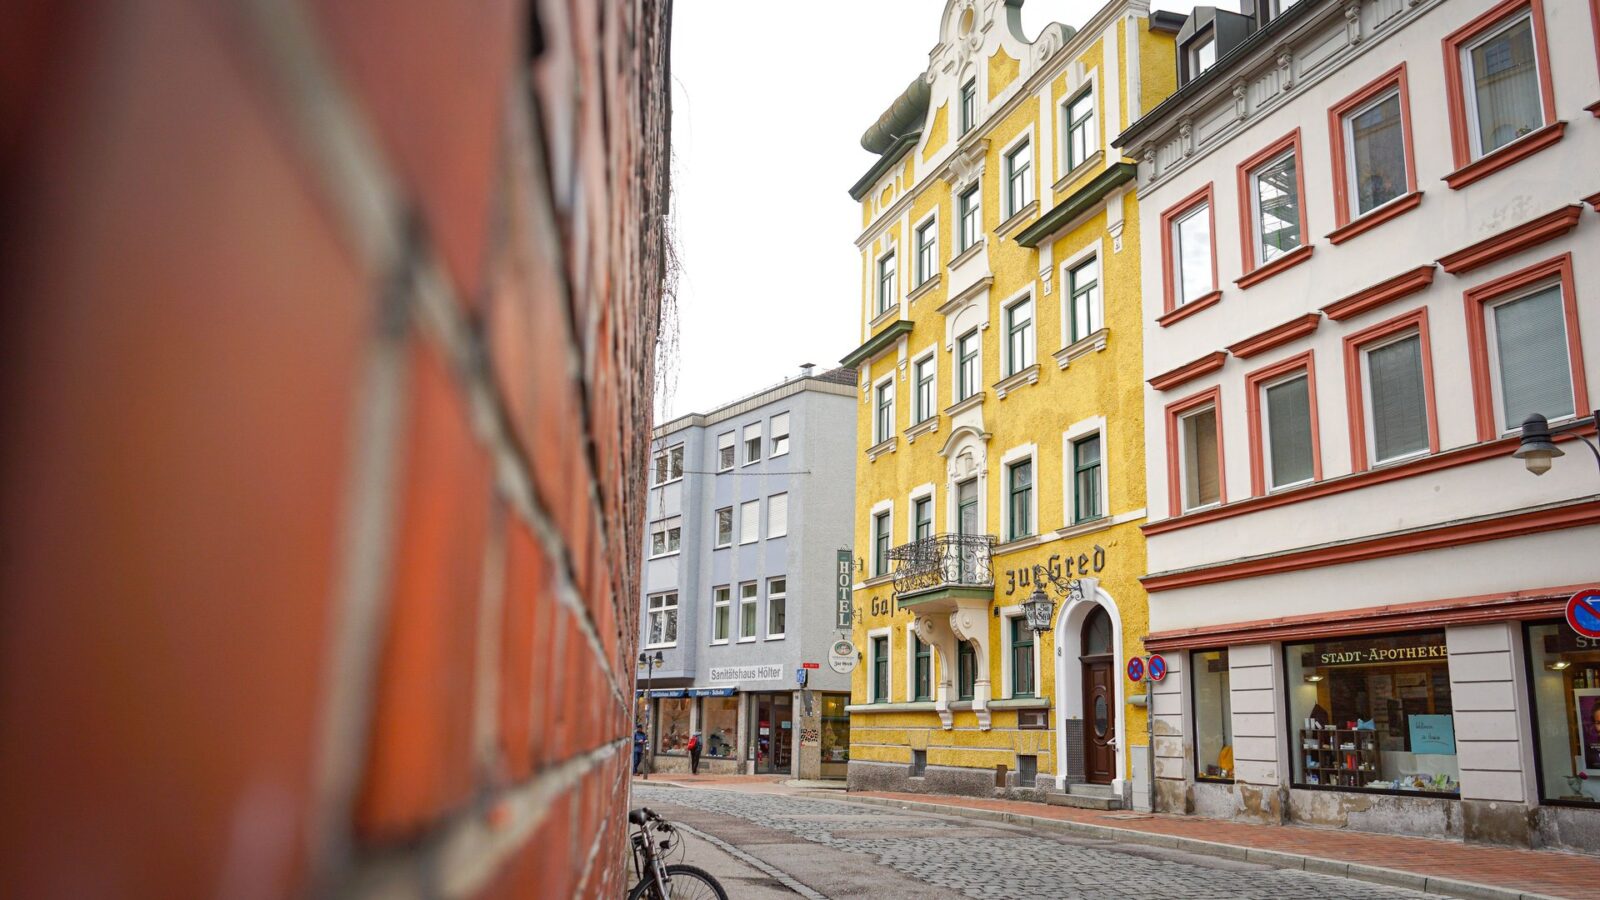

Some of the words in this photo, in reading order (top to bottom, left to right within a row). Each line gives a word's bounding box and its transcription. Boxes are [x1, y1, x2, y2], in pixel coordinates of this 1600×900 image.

[839, 561, 850, 626] HOTEL
[1057, 646, 1062, 657] 8
[1321, 645, 1448, 664] STADT-APOTHEKE
[711, 667, 756, 681] Sanitätshaus
[757, 665, 781, 679] Hölter
